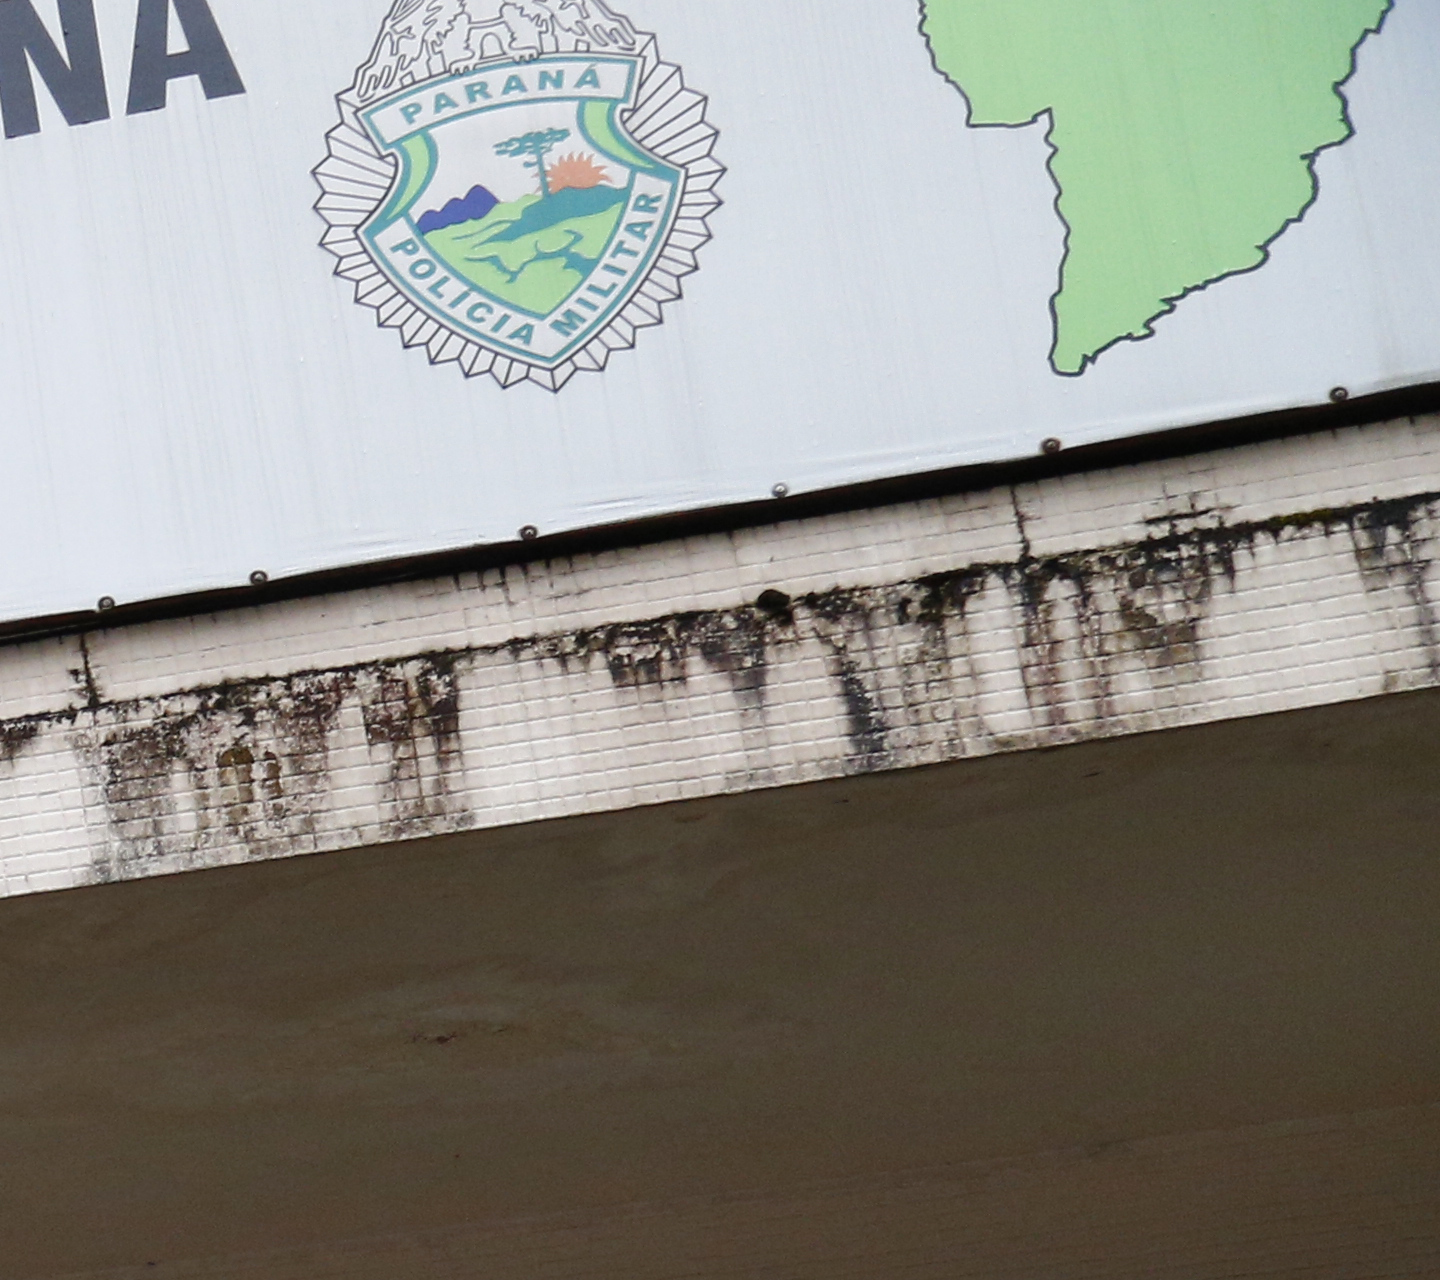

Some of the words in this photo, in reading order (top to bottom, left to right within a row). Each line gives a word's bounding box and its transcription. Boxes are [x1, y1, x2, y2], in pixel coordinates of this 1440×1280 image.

[399, 65, 601, 125] PARANÁ
[390, 237, 534, 345] POLÍCIA
[549, 192, 662, 338] MILITAR
